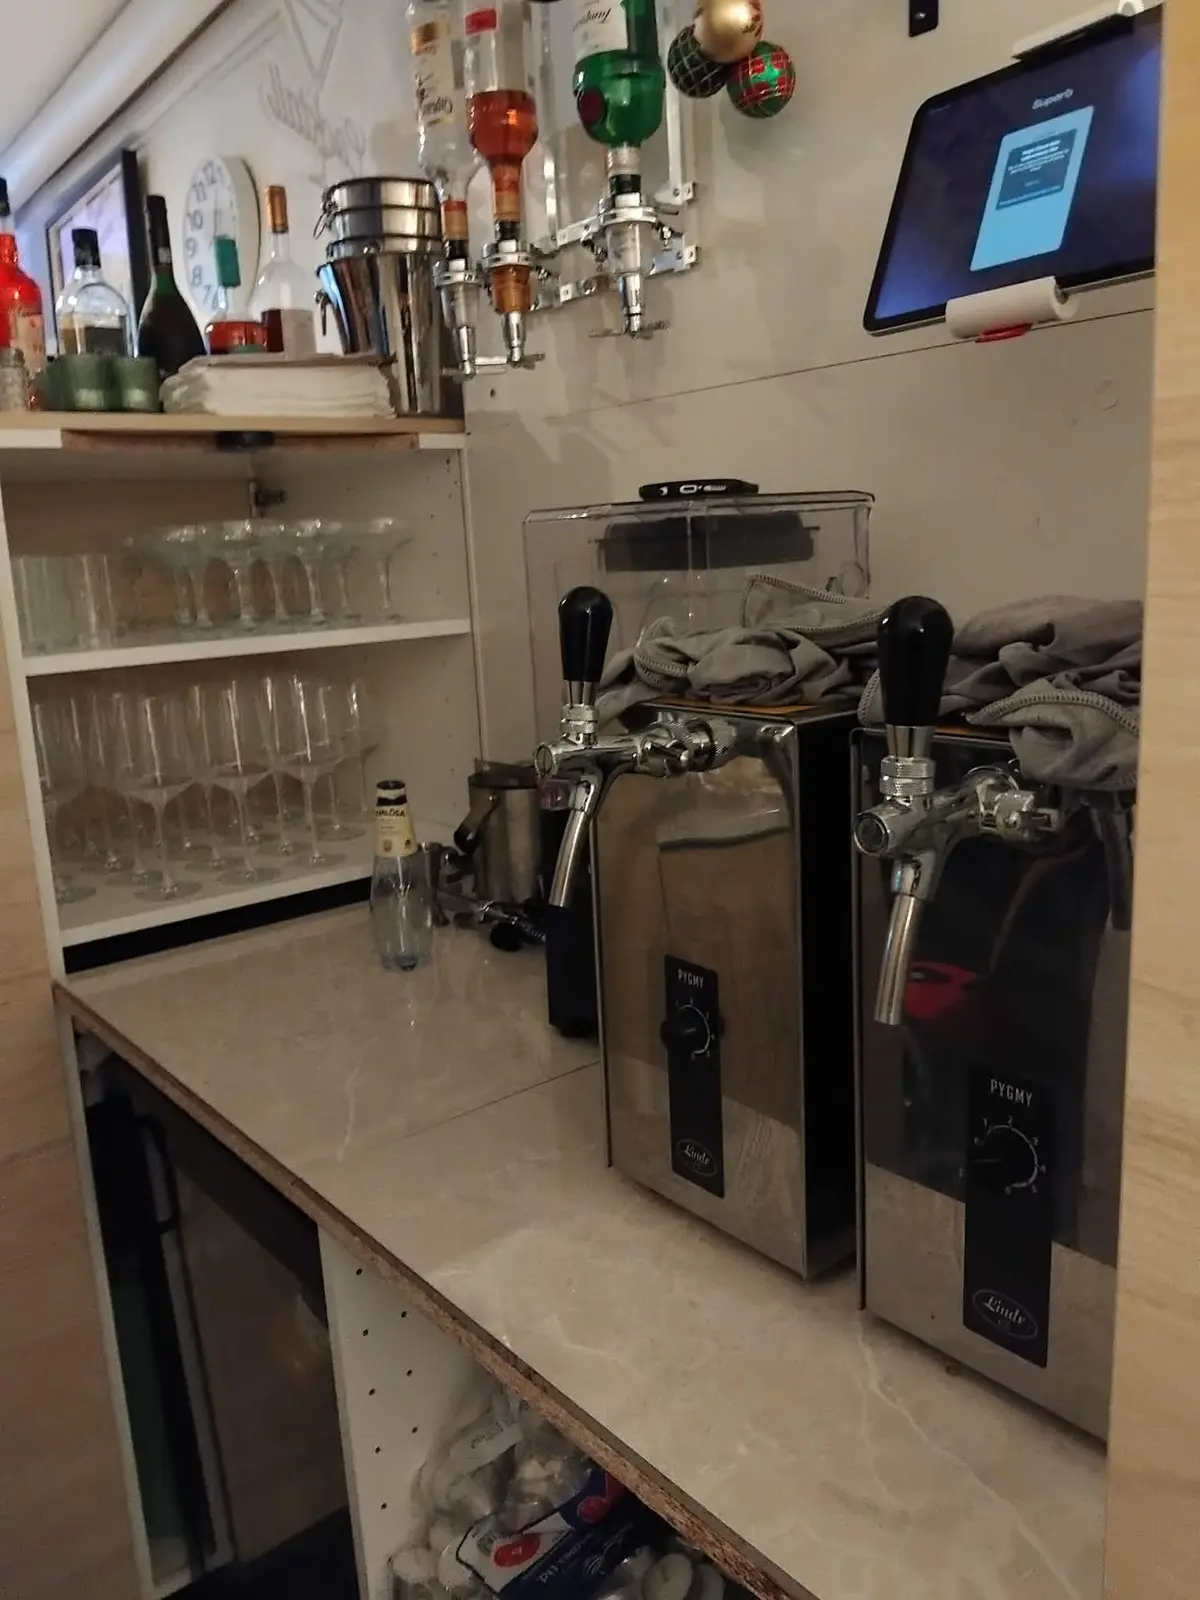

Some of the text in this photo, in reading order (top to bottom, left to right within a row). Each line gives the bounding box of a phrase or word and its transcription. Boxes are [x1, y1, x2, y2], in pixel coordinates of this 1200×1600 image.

[1032, 88, 1074, 110] Superb
[205, 162, 218, 184] 12
[192, 181, 207, 202] 11
[187, 210, 203, 232] 10
[187, 239, 198, 258] 9
[193, 266, 202, 286] 8
[202, 285, 211, 305] 7
[677, 969, 704, 989] PYGMY
[989, 1077, 1032, 1107] PYGMY
